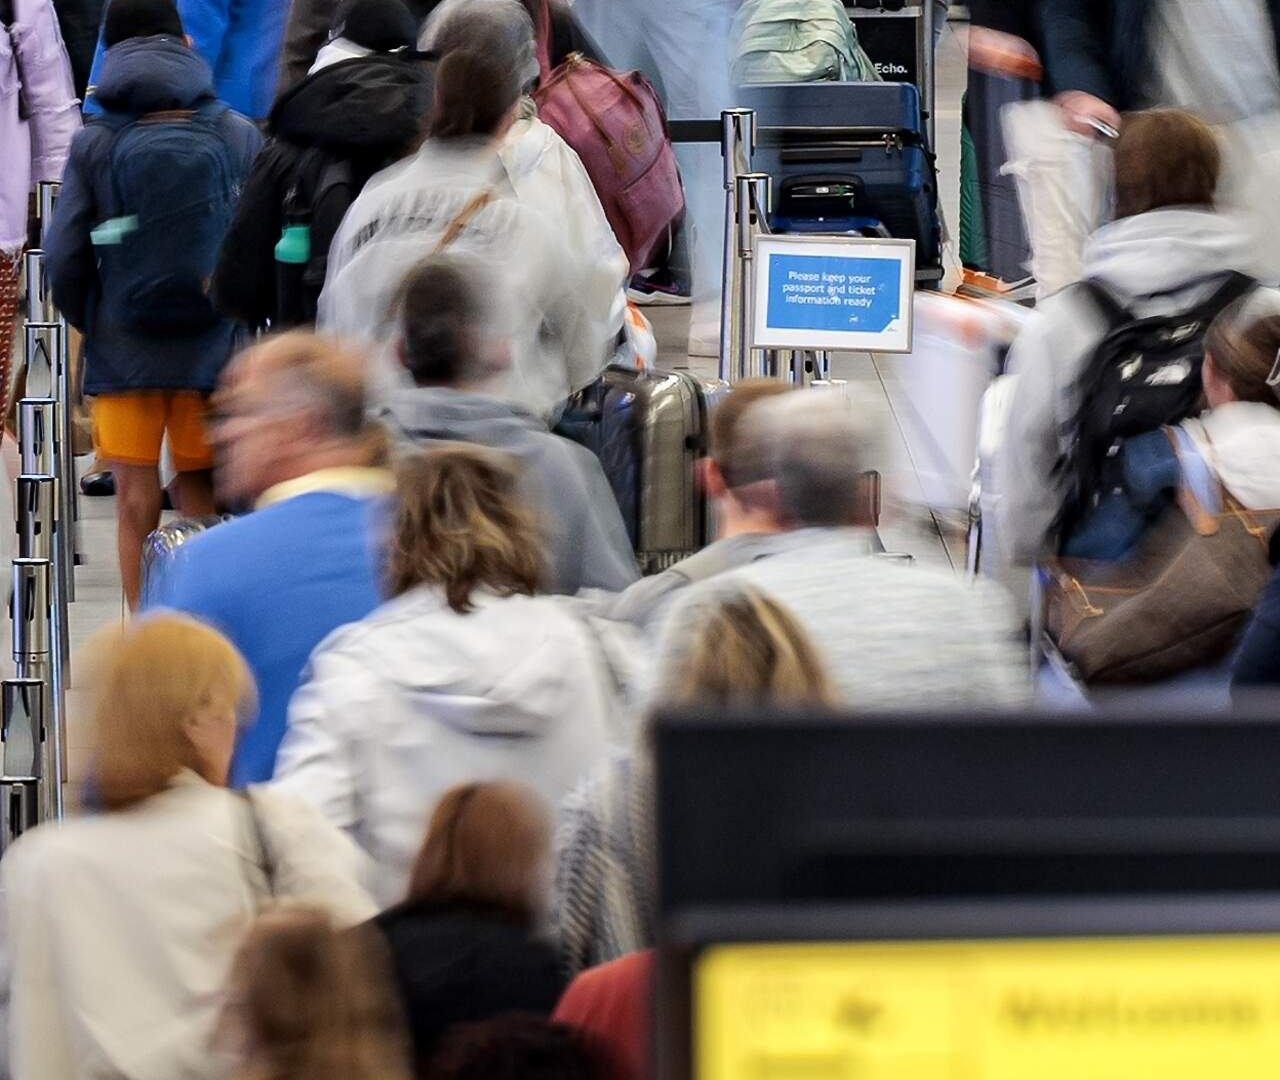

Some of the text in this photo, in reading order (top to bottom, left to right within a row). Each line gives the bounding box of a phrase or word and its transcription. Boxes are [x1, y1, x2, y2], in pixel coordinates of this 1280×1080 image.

[874, 62, 908, 74] Echo.
[788, 270, 872, 285] Please keep your
[782, 283, 876, 296] passport and ticket
[785, 294, 873, 308] information ready
